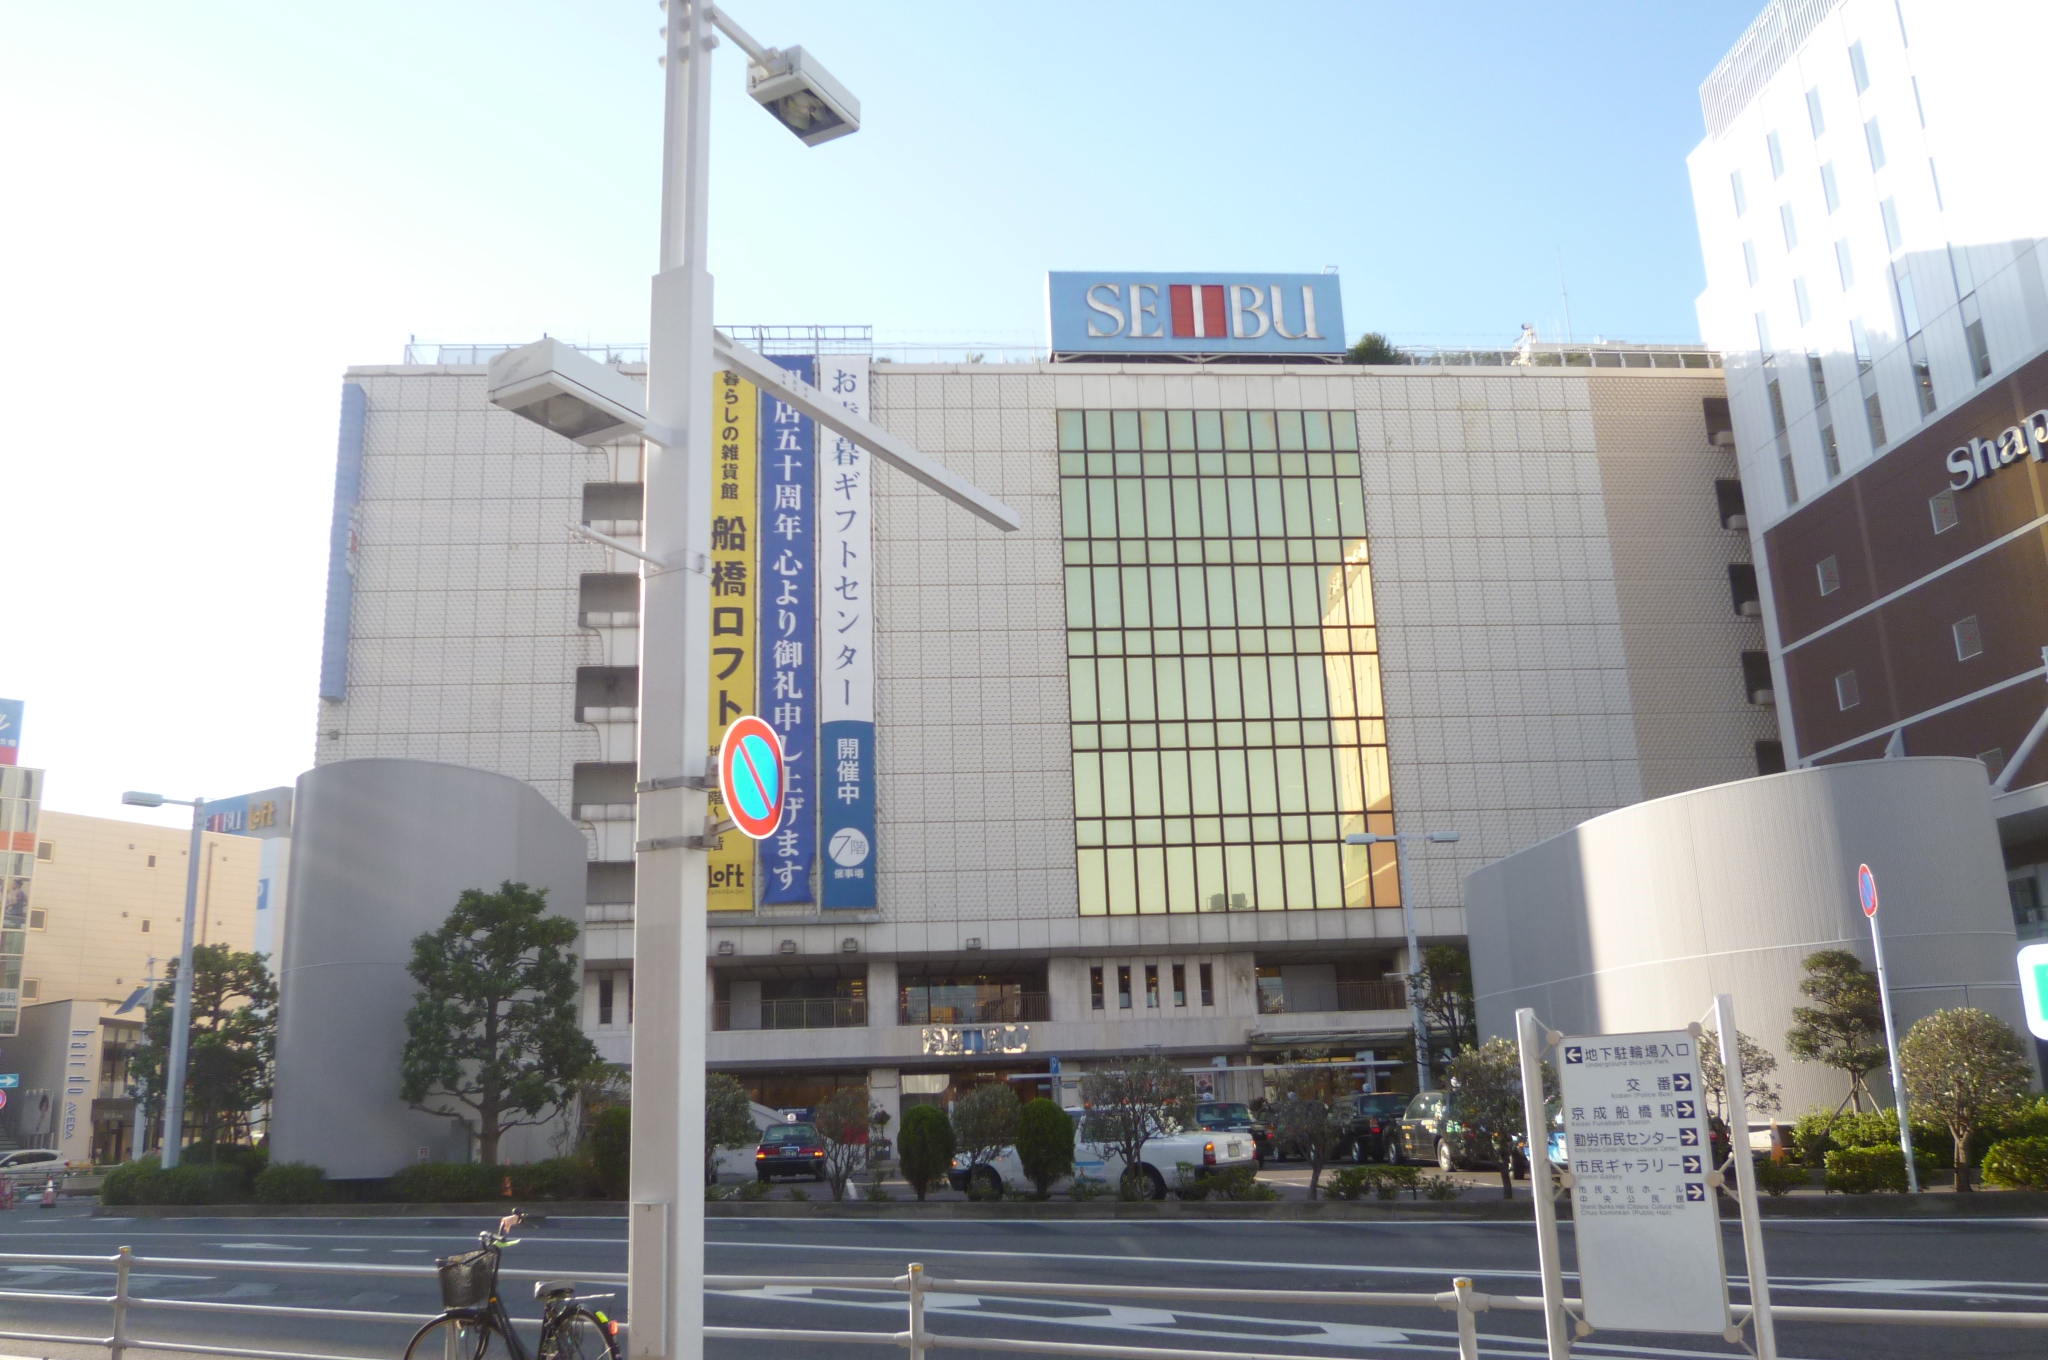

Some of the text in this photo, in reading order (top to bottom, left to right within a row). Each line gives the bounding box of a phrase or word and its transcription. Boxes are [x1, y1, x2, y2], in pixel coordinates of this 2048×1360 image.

[1086, 283, 1326, 339] SEIBU
[711, 516, 748, 727] 船橋ロフト
[837, 738, 860, 805] 開催中
[834, 835, 866, 861] 7階
[834, 868, 865, 879] 催事場
[1584, 1043, 1690, 1061] 地下駐輪場入口
[67, 1030, 96, 1094] hair do
[1626, 1077, 1671, 1091] 交番
[1571, 1104, 1675, 1120] 京成船橋駅
[64, 1102, 77, 1140] AVEDA
[1573, 1132, 1677, 1146] 勤労市民センター
[1575, 1158, 1680, 1173] 市民ギャラリー
[1578, 1185, 1684, 1194] 市民文化ホール
[1579, 1195, 1685, 1203] 中央公民館
